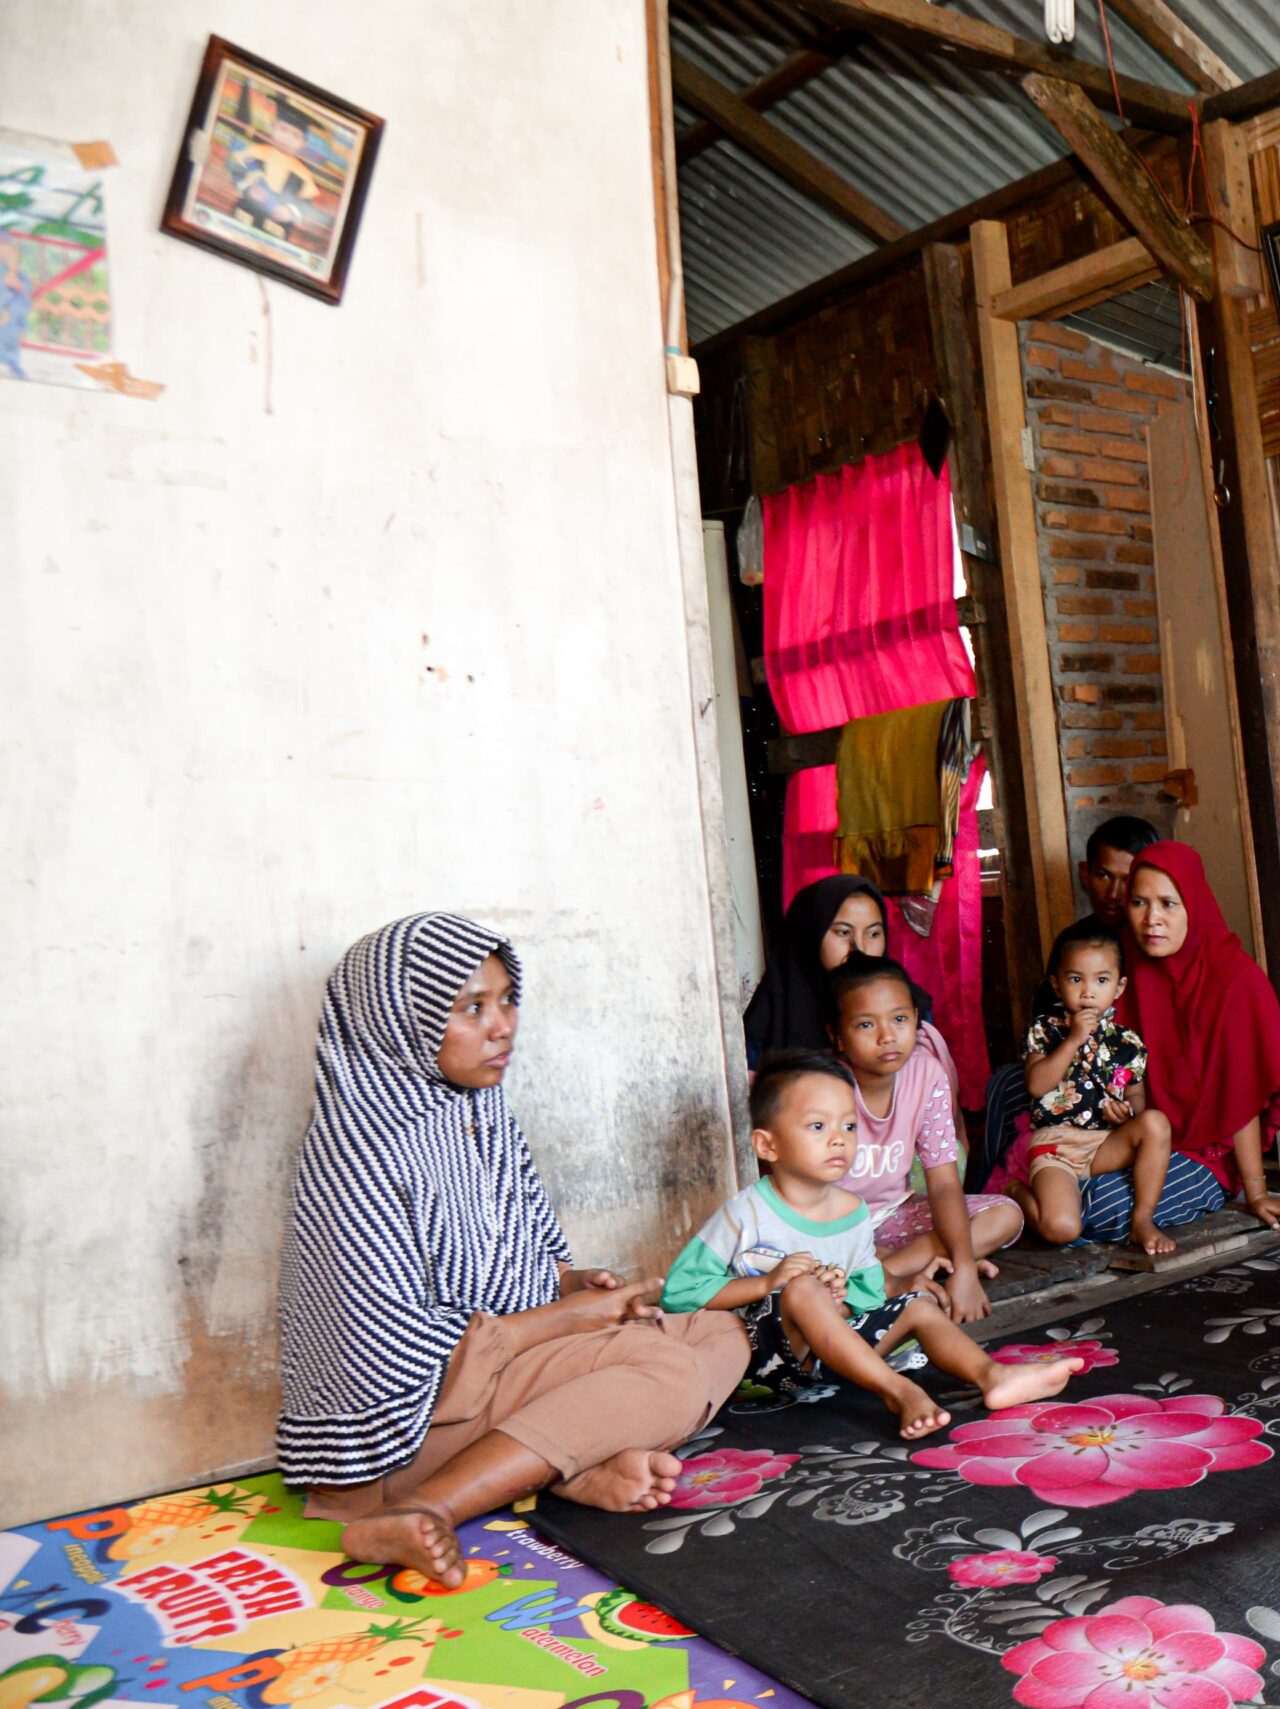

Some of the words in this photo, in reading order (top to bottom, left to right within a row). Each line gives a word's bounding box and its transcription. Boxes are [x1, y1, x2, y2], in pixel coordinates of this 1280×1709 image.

[505, 1529, 585, 1570] trawberry
[115, 1565, 238, 1645] FRUITS
[190, 1550, 304, 1620] FRESH
[343, 1584, 387, 1610] range
[520, 1626, 607, 1679] atermelon
